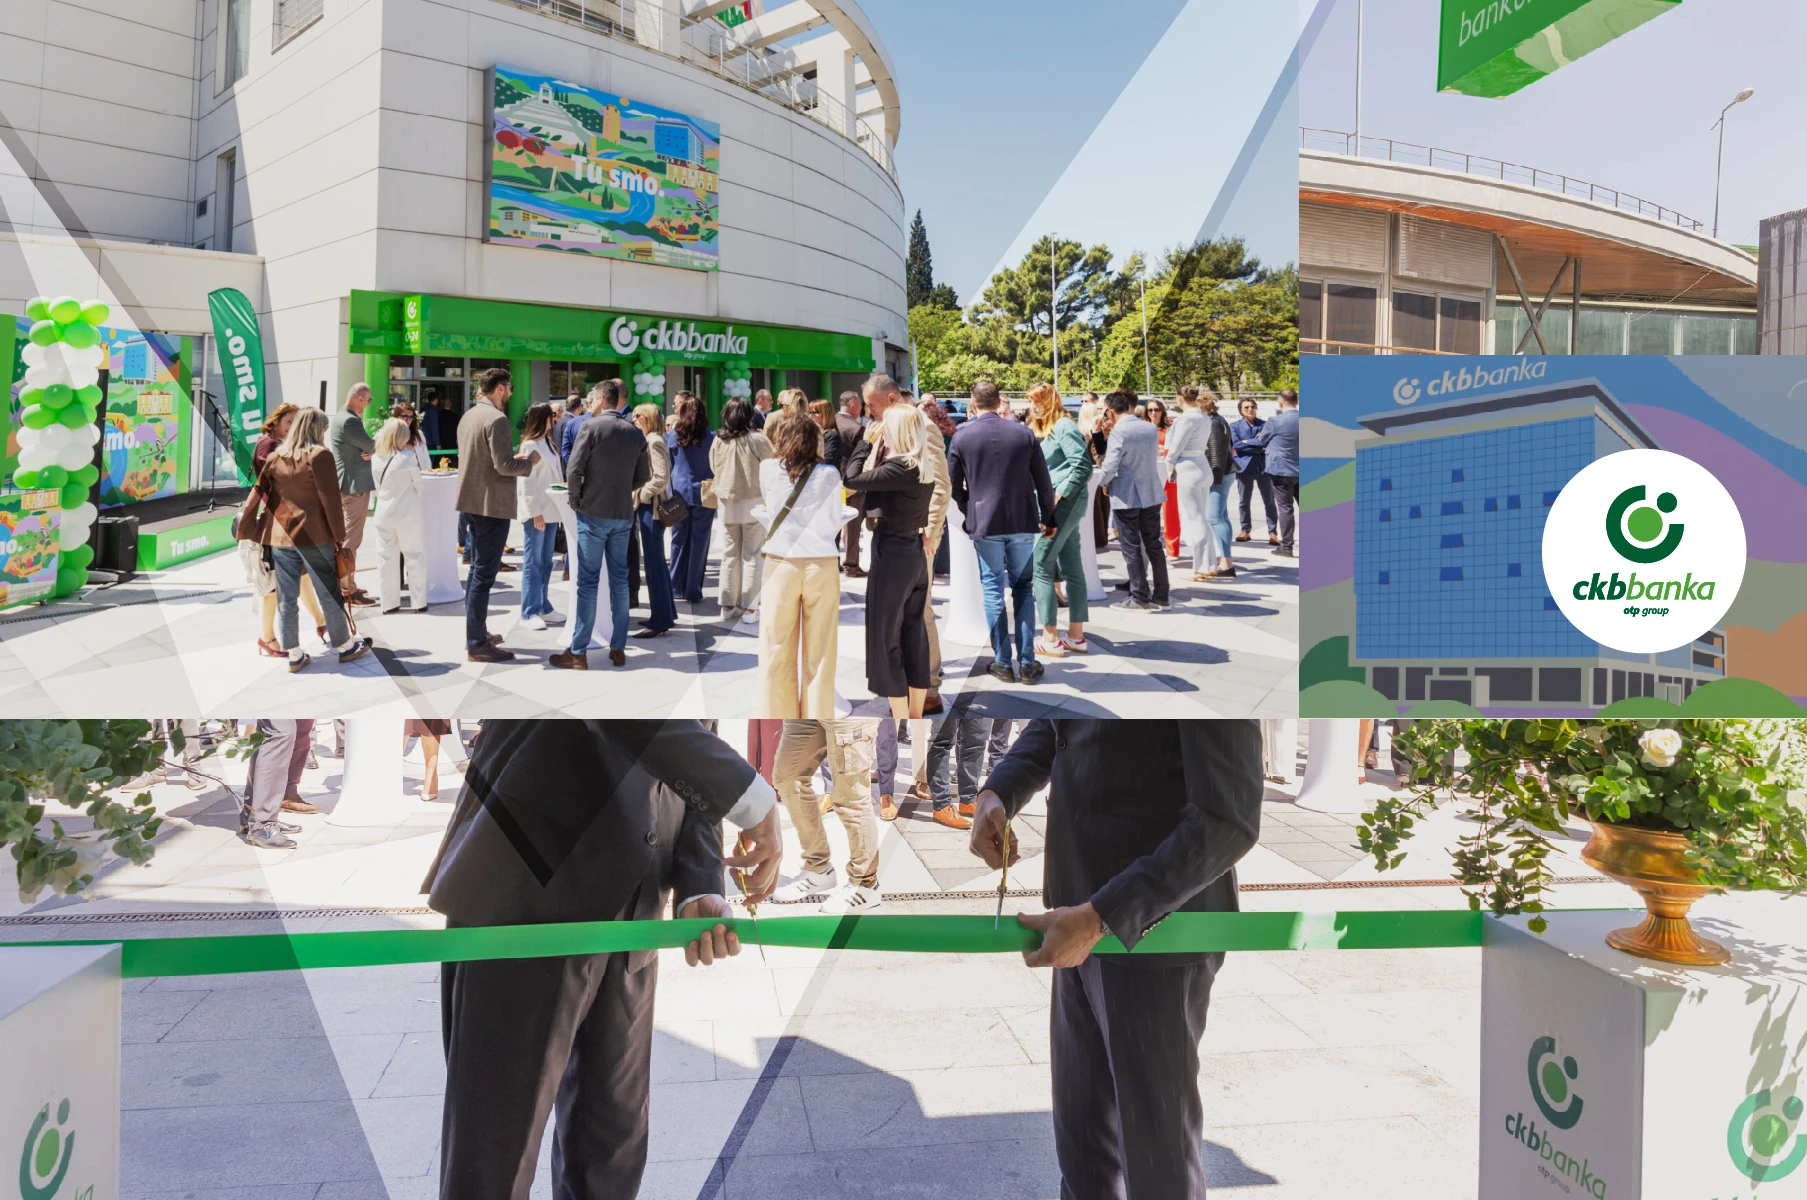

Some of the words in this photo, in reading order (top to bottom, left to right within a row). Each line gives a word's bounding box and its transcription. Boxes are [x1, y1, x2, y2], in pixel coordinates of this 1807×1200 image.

[1459, 0, 1532, 47] bank
[571, 153, 602, 184] Tu
[609, 168, 665, 197] smo.
[642, 320, 748, 355] ckbbanka
[1427, 357, 1547, 396] ckbbanka
[106, 431, 140, 451] mo.
[170, 540, 184, 557] Tu
[185, 535, 210, 552] smo.
[1505, 1112, 1607, 1200] ckbbanka
[1537, 1165, 1550, 1179] otp
[1549, 1174, 1570, 1194] group
